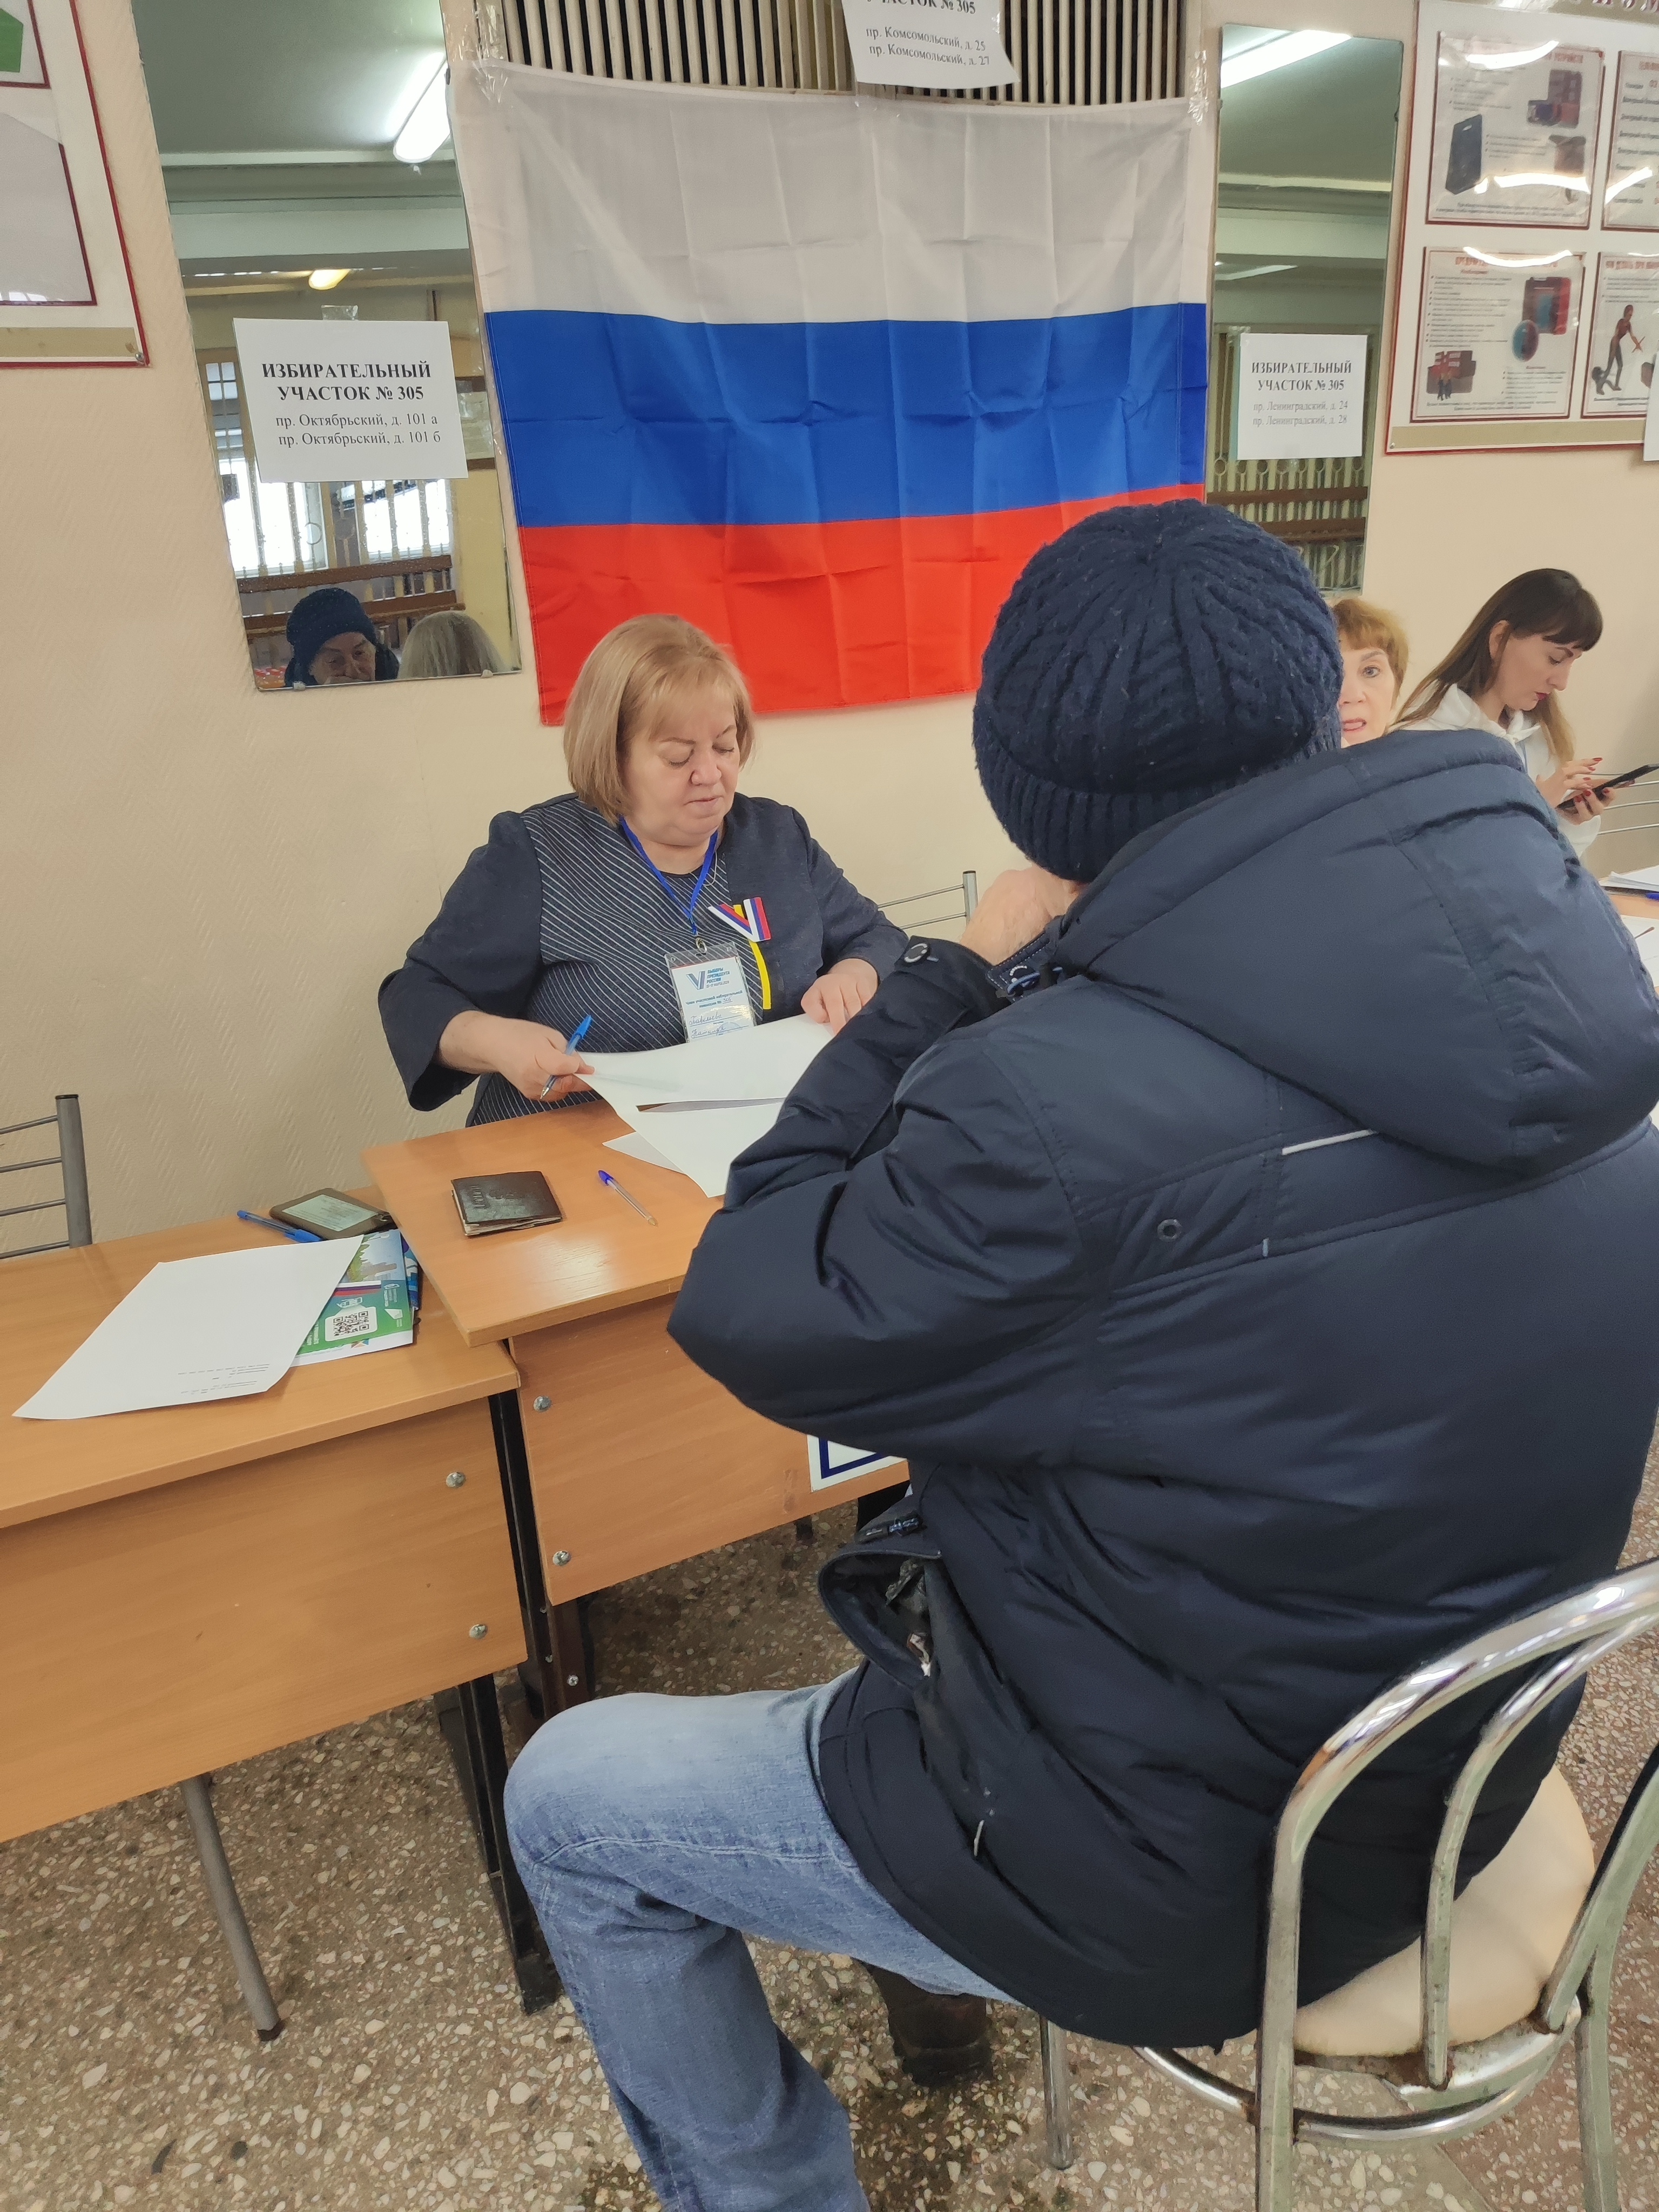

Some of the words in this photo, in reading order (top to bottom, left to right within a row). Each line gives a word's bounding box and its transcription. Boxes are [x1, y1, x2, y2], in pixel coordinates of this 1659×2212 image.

[957, 0, 976, 14] 305
[866, 28, 882, 40] пр.
[885, 26, 963, 49] Комсомольский,
[975, 40, 986, 51] 25
[869, 45, 885, 57] пр.
[888, 44, 967, 66] Комсомольский,
[979, 56, 990, 65] 27
[261, 360, 431, 378] ИЗБИРАТЕЛЬНЫЙ
[1251, 360, 1352, 374] ИЗБИРАТЕЛЬНЫЙ
[1258, 380, 1313, 391] УЧАСТОК
[1314, 380, 1326, 391] №
[1327, 379, 1345, 390] 305
[276, 386, 371, 400] УЧАСТОК
[375, 386, 393, 400] №
[397, 386, 424, 400] 305
[1253, 403, 1265, 413] пр.
[1266, 401, 1328, 413] Ленинградский,
[1339, 400, 1348, 410] 24
[275, 417, 295, 429] пр.
[299, 414, 388, 429] Октябрьский,
[391, 416, 402, 427] д.
[407, 413, 426, 424] 101
[431, 416, 438, 424] а
[1252, 417, 1265, 427] пр.
[1266, 415, 1327, 427] Ленинградский,
[1338, 414, 1348, 424] 28
[278, 436, 299, 448] пр.
[302, 431, 390, 447] Октябрьский,
[394, 434, 404, 444] д.
[409, 431, 428, 443] 101
[433, 430, 441, 443] б
